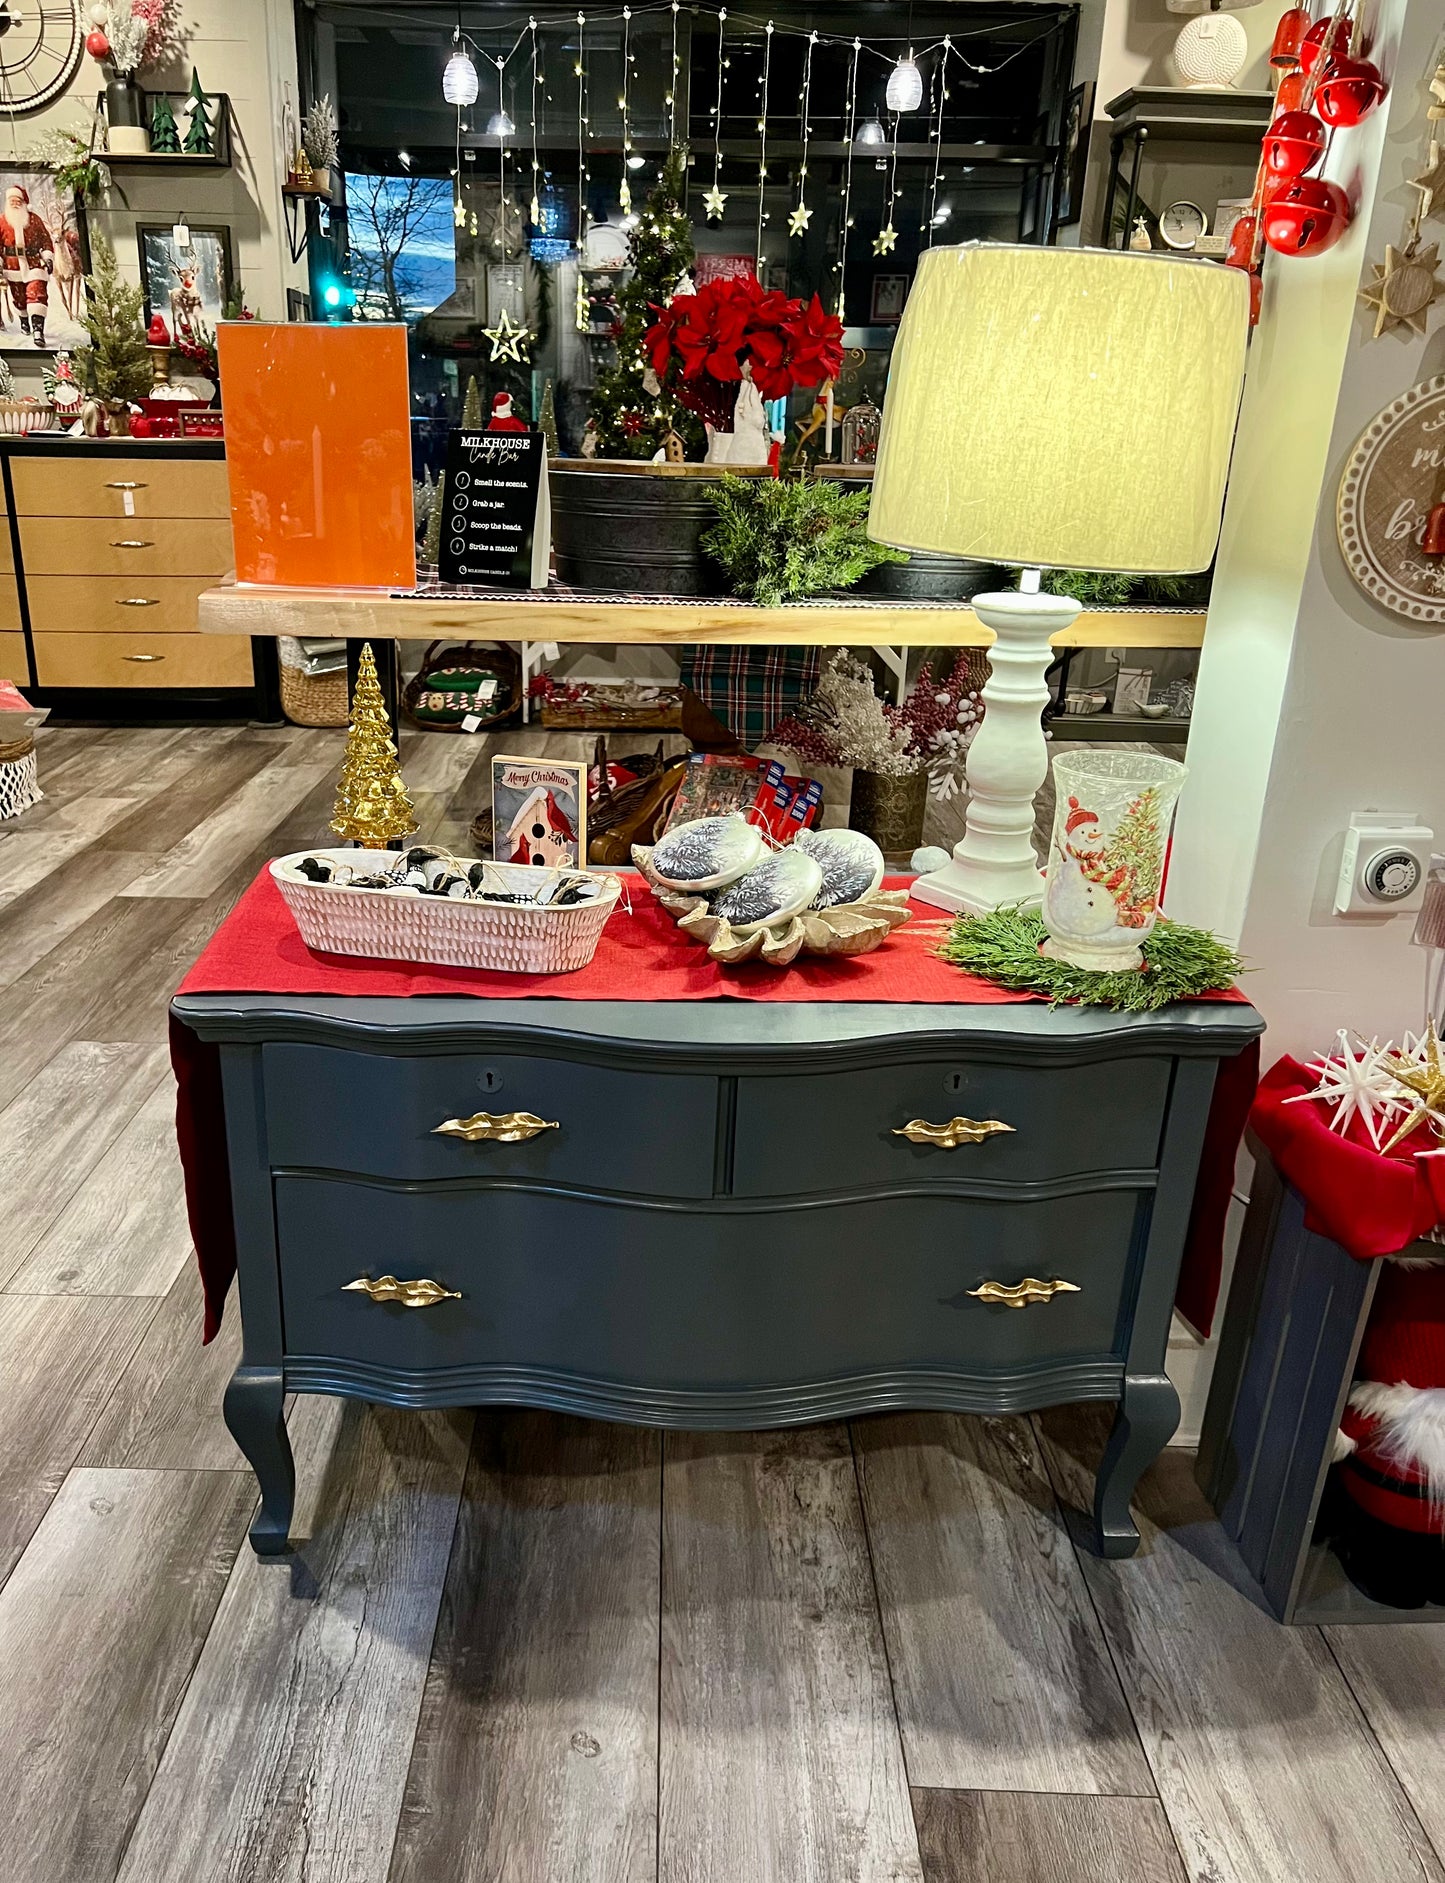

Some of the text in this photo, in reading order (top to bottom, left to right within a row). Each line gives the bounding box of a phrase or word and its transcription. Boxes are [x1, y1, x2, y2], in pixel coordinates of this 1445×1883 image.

[460, 436, 530, 449] MILKHOUSE
[498, 446, 519, 465] Bar
[470, 521, 489, 530] Scoop
[469, 543, 488, 551] Strike
[507, 771, 569, 786] Merry Christmas
